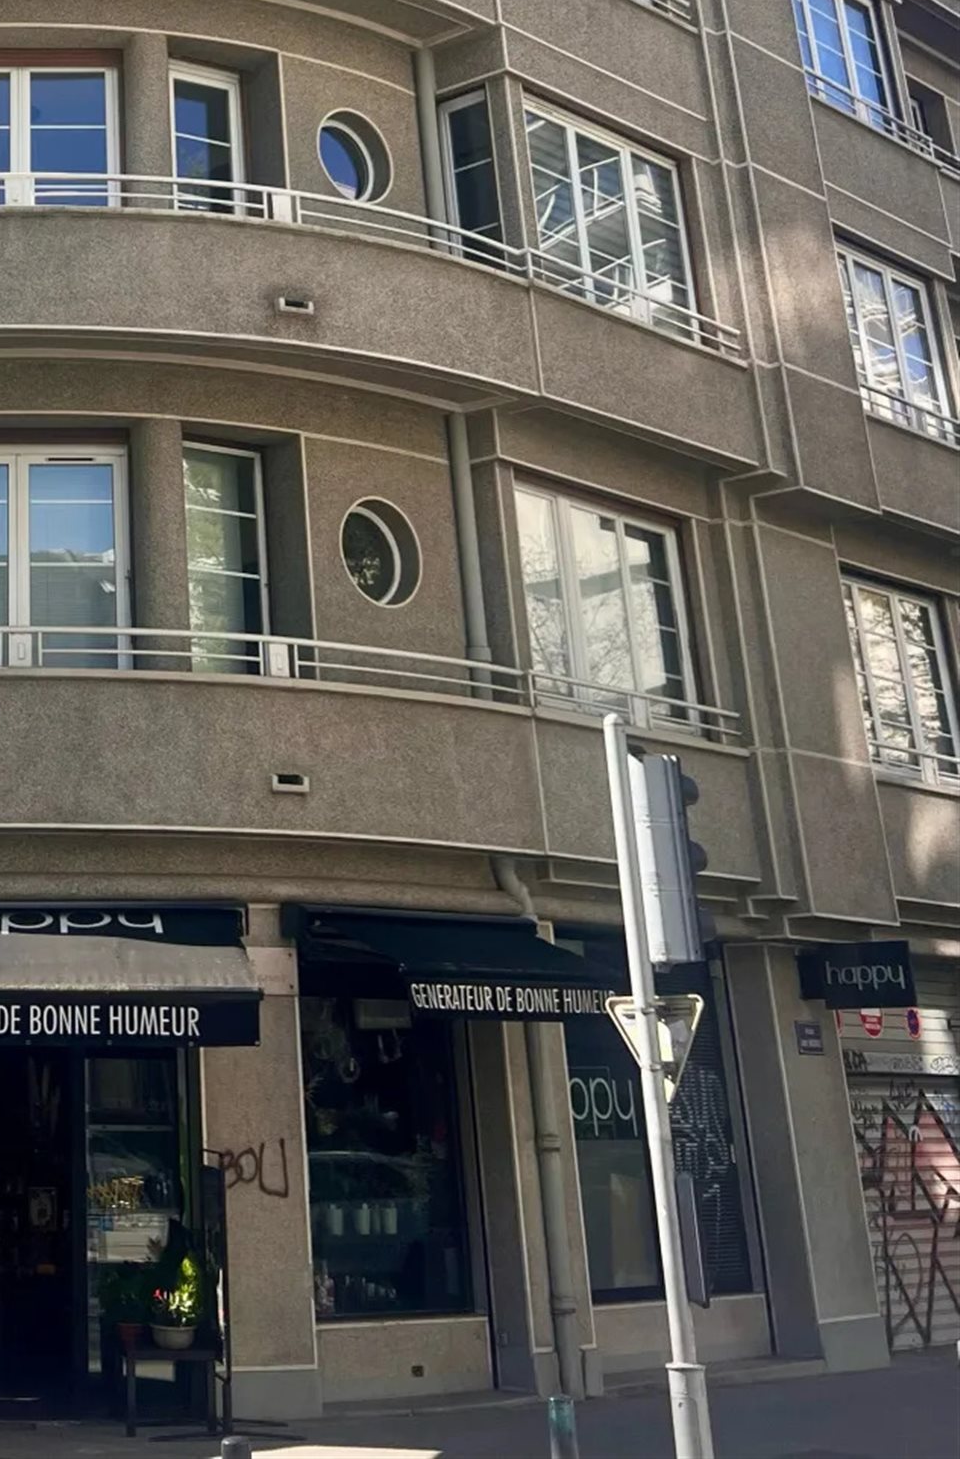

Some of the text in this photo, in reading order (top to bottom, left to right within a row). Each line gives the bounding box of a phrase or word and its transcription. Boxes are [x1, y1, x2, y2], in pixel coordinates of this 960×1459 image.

[825, 961, 906, 990] happy
[411, 983, 616, 1014] GENERATEUR DE BONNE HUMEU
[29, 1005, 101, 1036] BONNE
[109, 1006, 200, 1037] HUMEUR
